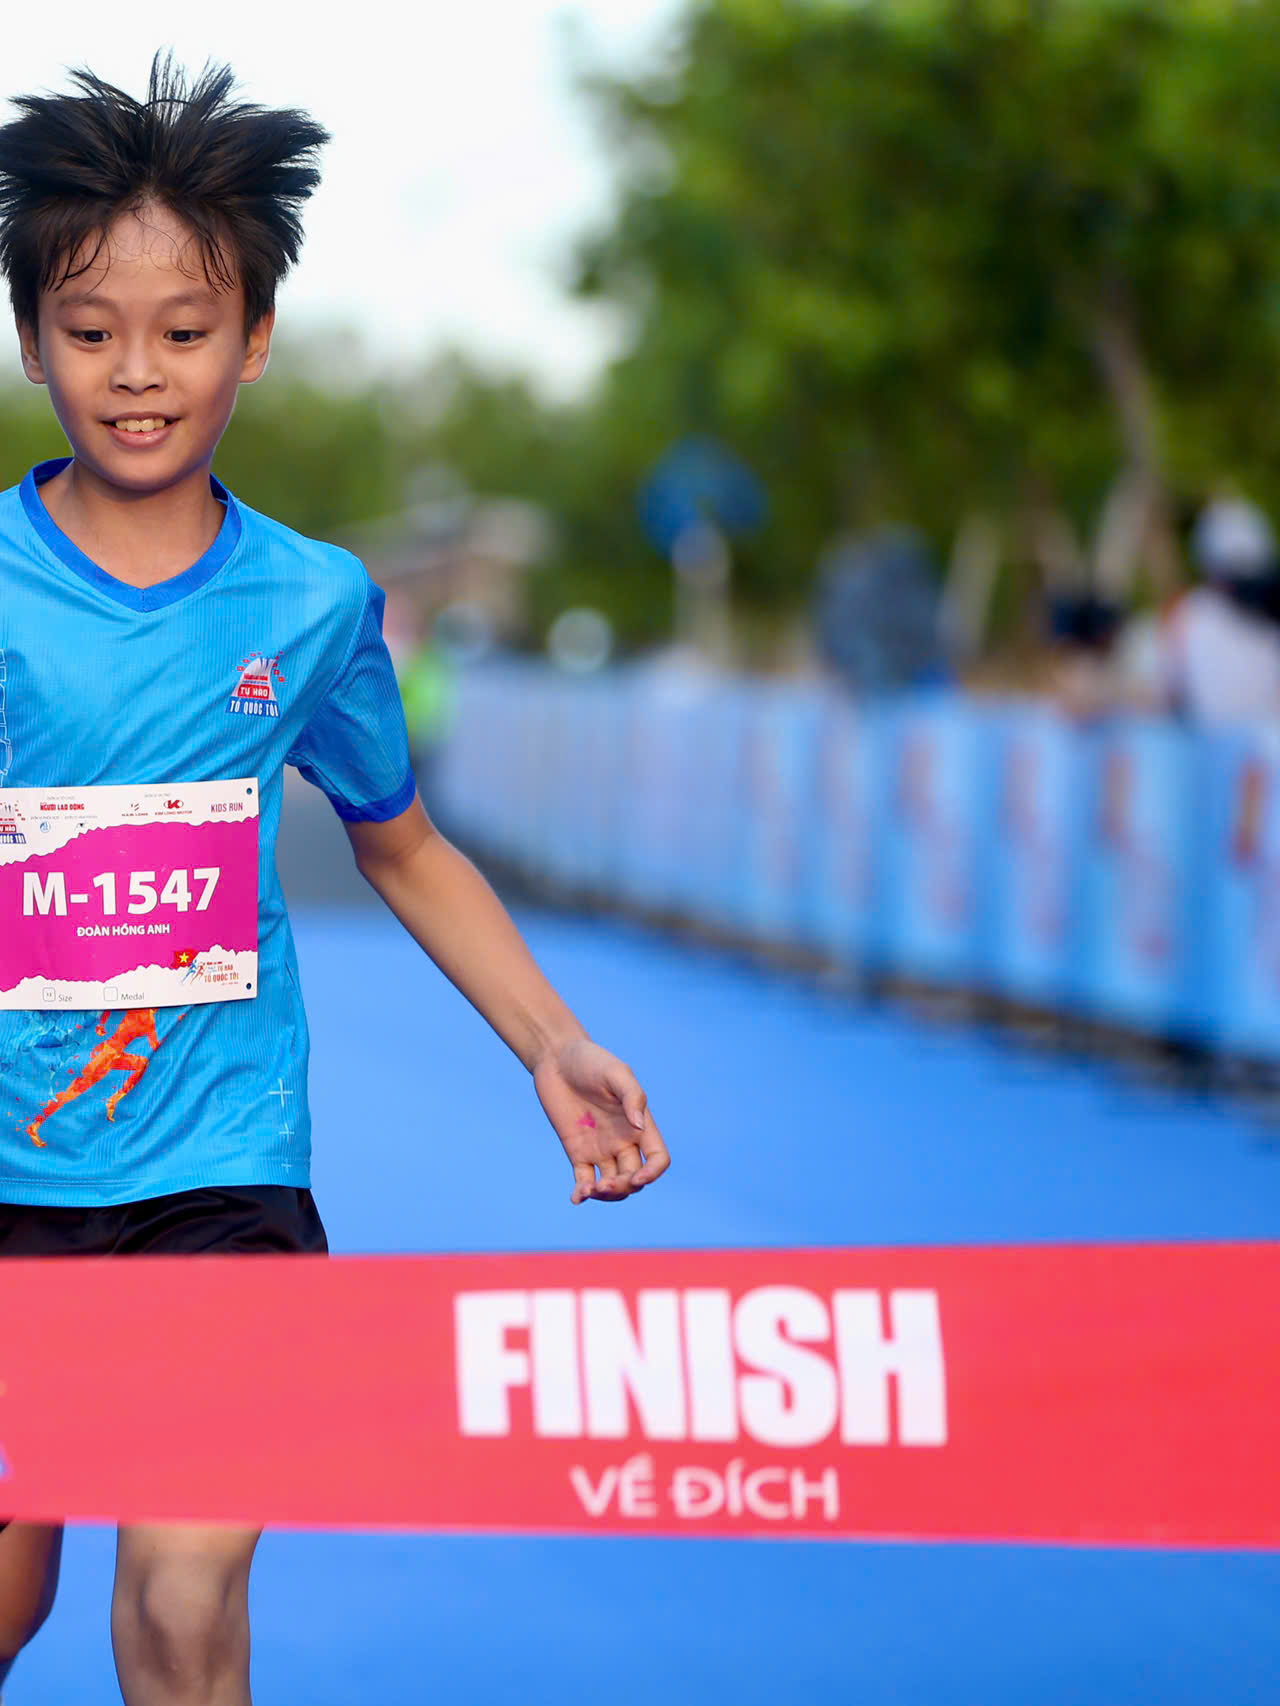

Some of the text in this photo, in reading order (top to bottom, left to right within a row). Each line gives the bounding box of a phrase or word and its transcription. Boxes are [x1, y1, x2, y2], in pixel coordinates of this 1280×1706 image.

[210, 802, 244, 813] KIDS RUN
[22, 866, 221, 917] M-1547
[76, 924, 110, 937] ĐOÀN
[147, 923, 170, 935] ANH
[58, 993, 73, 1003] Size
[120, 991, 145, 1001] Medal
[453, 1284, 949, 1449] FINISH
[669, 1456, 839, 1521] ĐÍCH
